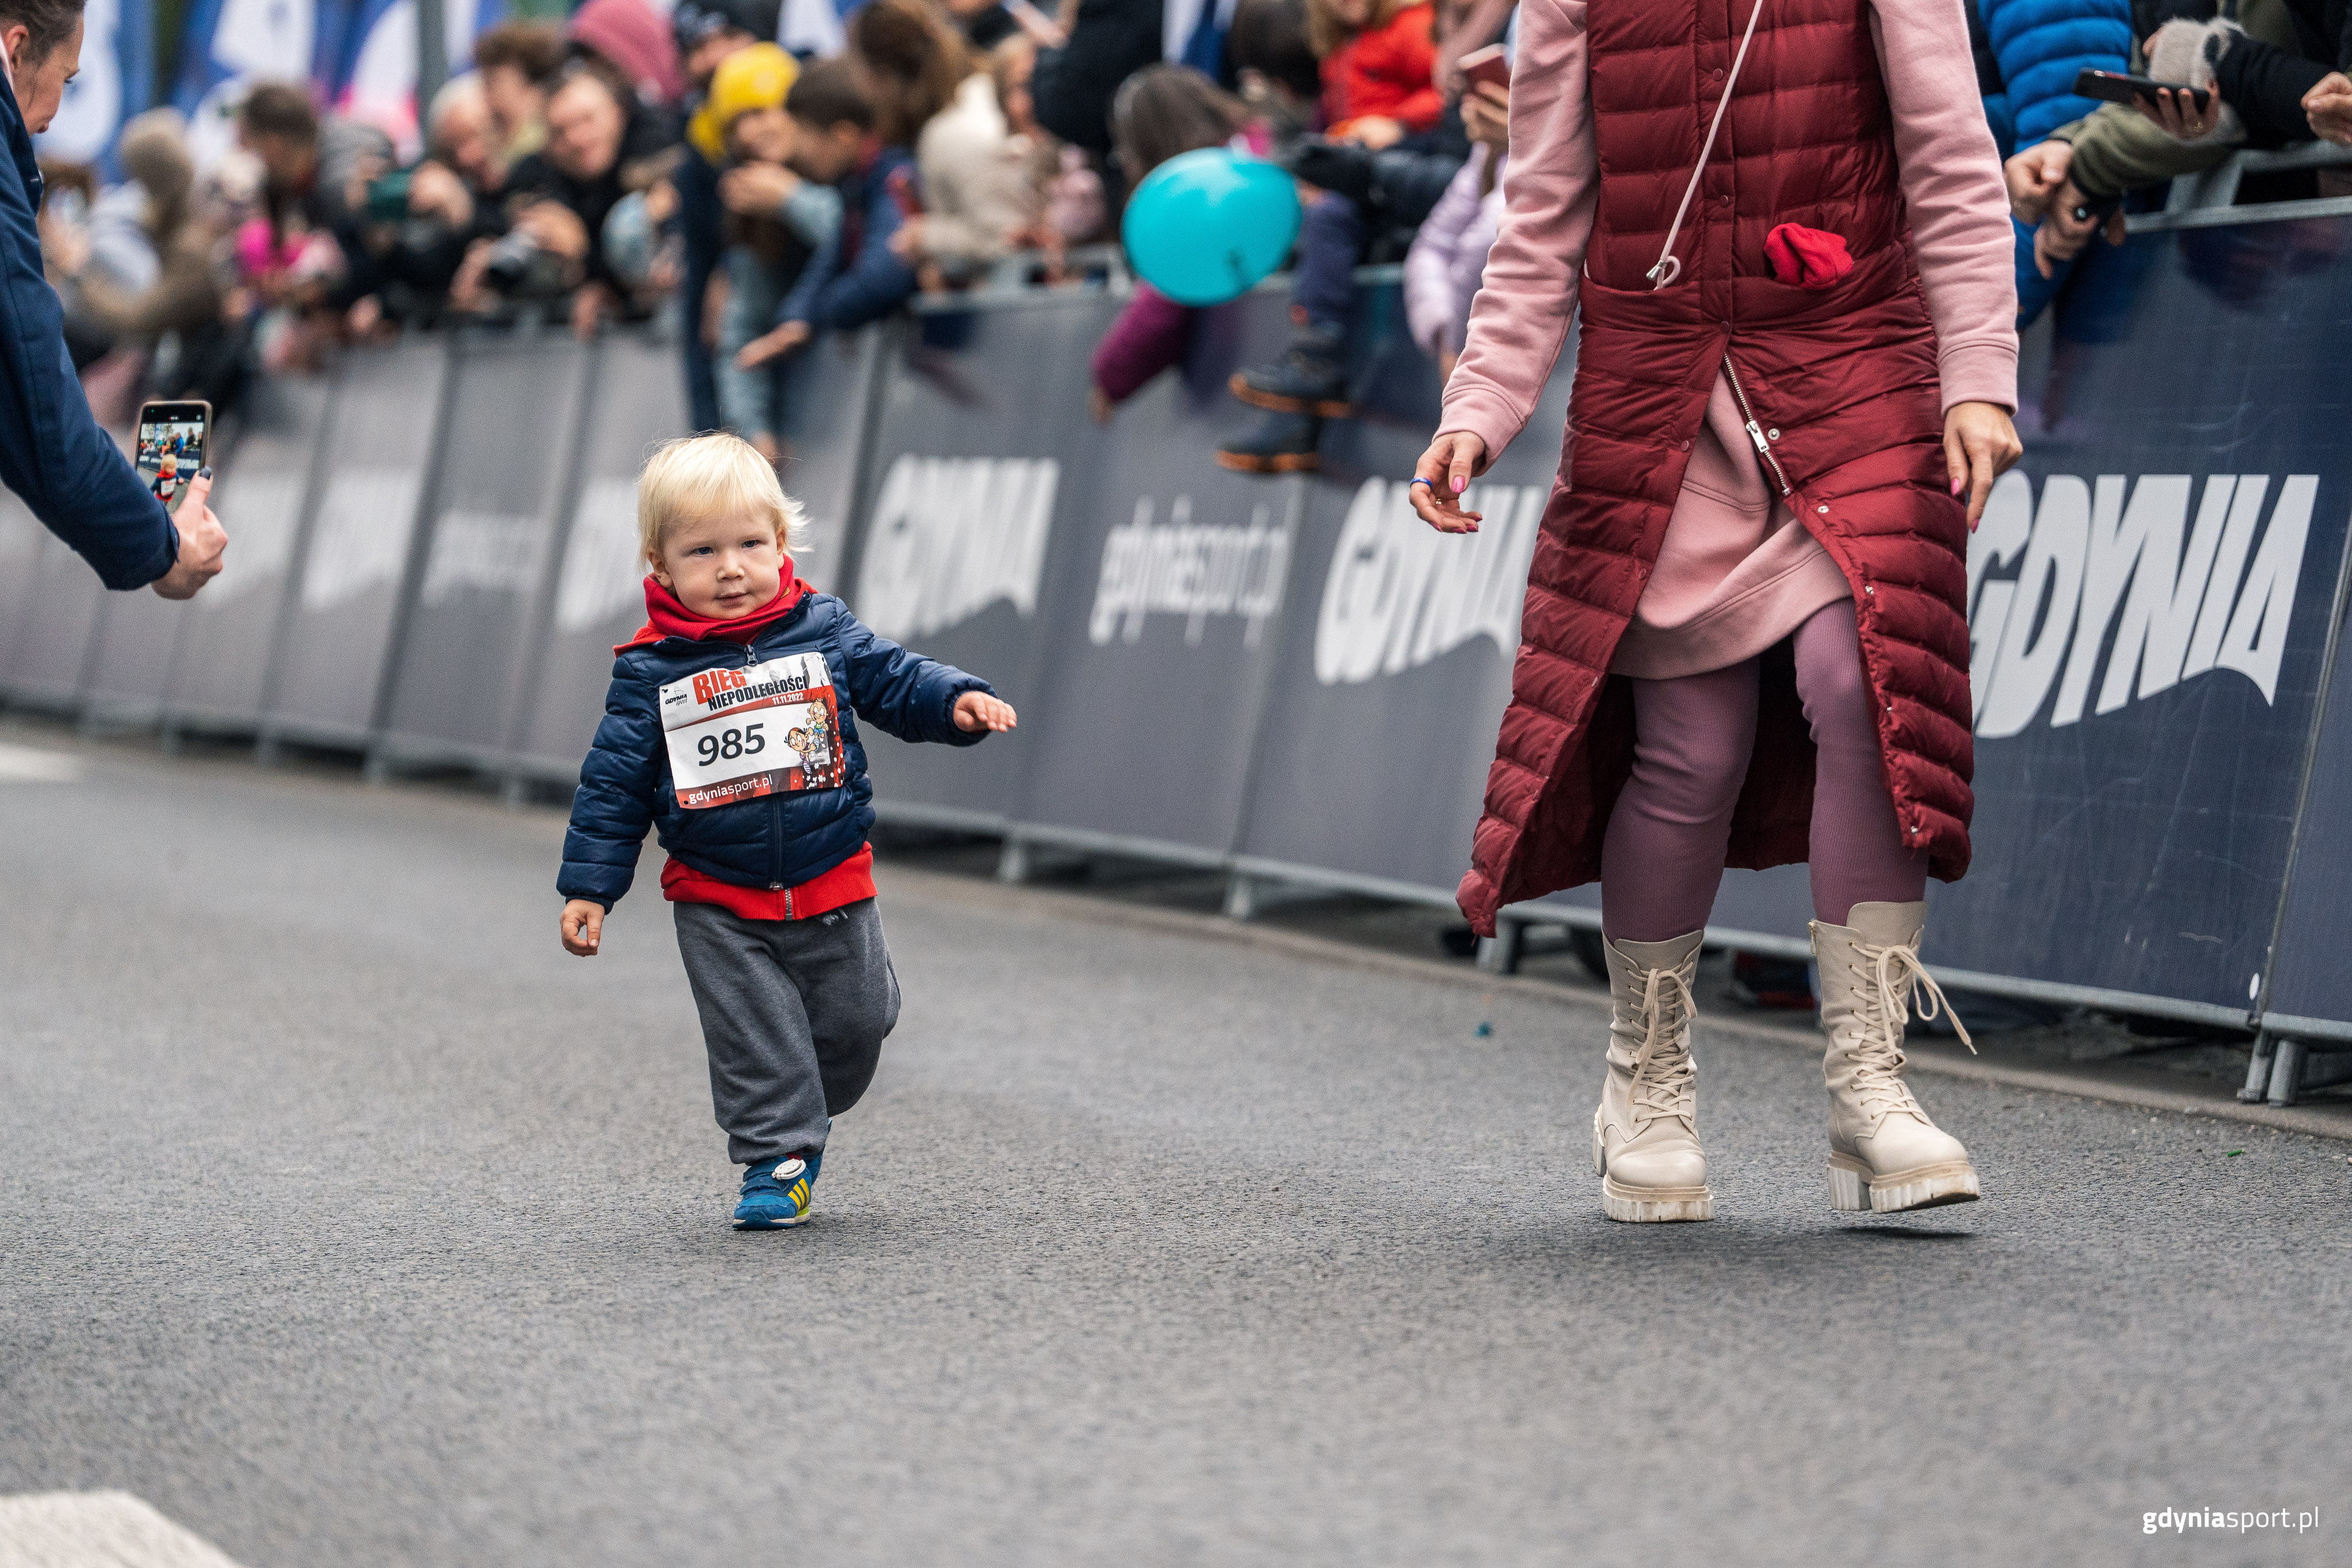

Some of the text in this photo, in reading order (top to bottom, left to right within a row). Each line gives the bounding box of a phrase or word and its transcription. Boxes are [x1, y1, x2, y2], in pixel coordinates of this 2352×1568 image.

[1967, 469, 2320, 739] GDYNIA
[665, 694, 687, 704] GDYNIA
[676, 698, 687, 706] sport
[693, 669, 746, 705] BIEG
[707, 675, 807, 711] NIEPODLEGŁOŚCI
[771, 692, 804, 706] 11.11.2022
[697, 722, 765, 766] 985
[688, 773, 772, 804] gdyniasport.pl
